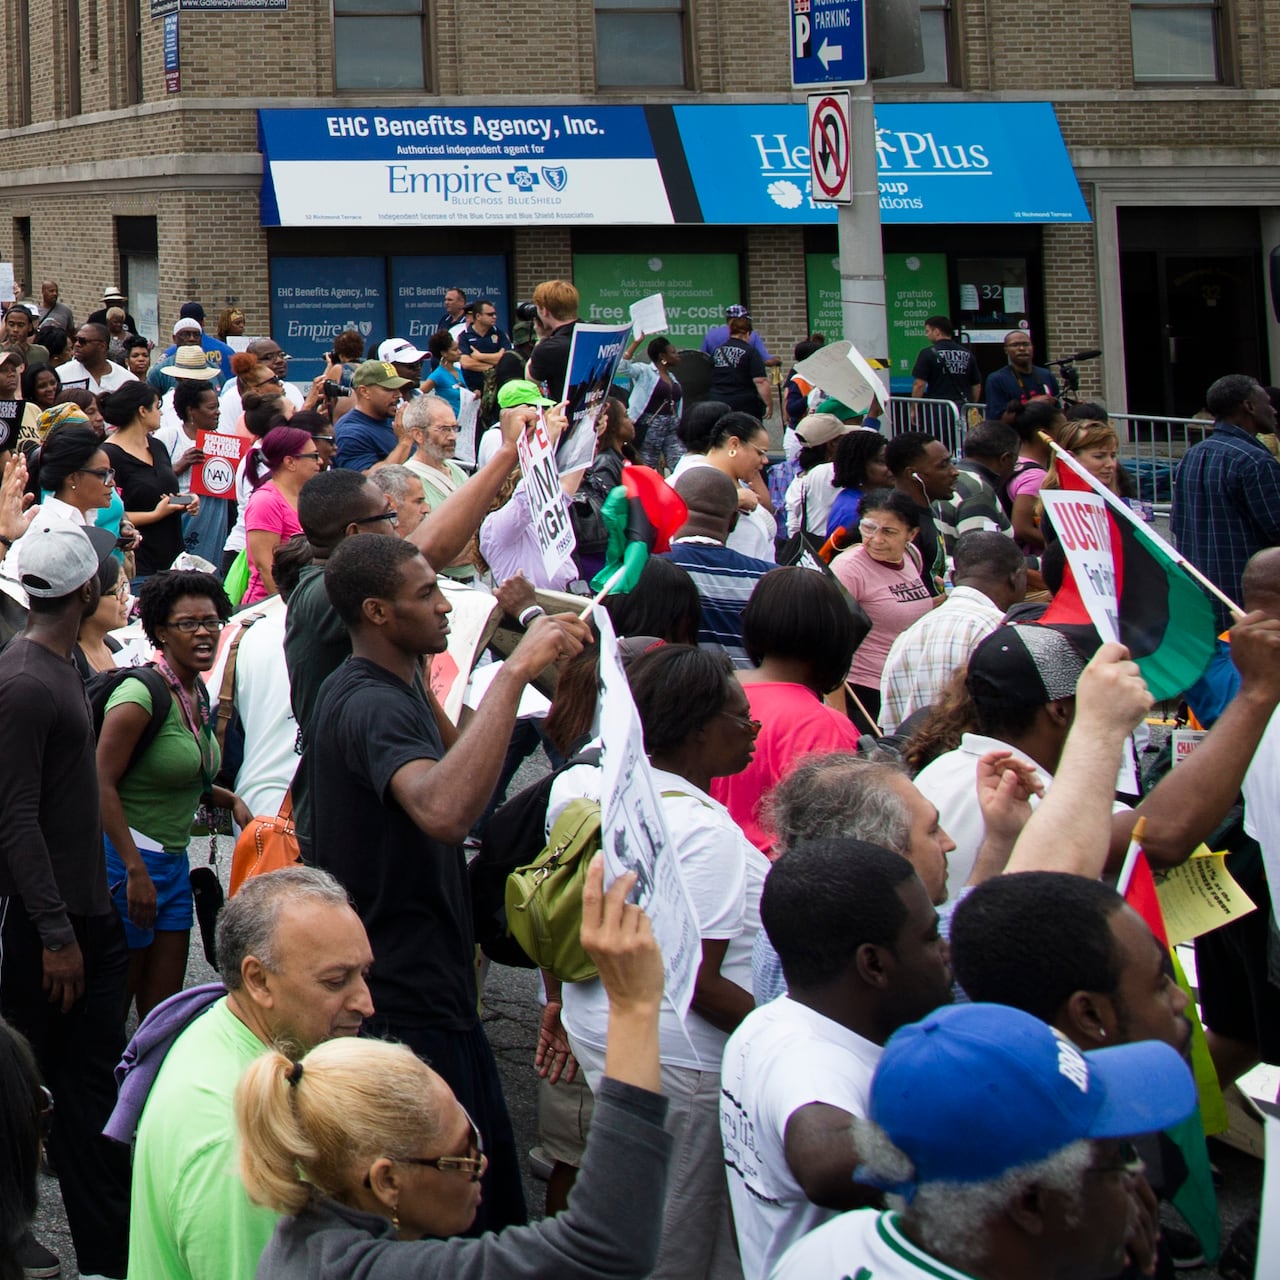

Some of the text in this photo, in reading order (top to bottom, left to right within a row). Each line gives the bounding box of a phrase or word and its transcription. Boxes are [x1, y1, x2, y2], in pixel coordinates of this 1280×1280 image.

[815, 8, 851, 30] PARKING
[326, 114, 605, 141] EHC Benefits Agency, Inc.
[396, 144, 545, 157] Authorized independent agent for
[385, 165, 503, 202] Empire
[621, 280, 692, 288] Ask inside about
[277, 287, 380, 299] EHC Benefits Agency, Inc.
[896, 289, 933, 300] gratuito
[982, 285, 1002, 300] 32
[904, 310, 928, 318] costo
[287, 320, 342, 342] Empire
[207, 468, 230, 483] NAN
[1211, 888, 1231, 915] FORUM
